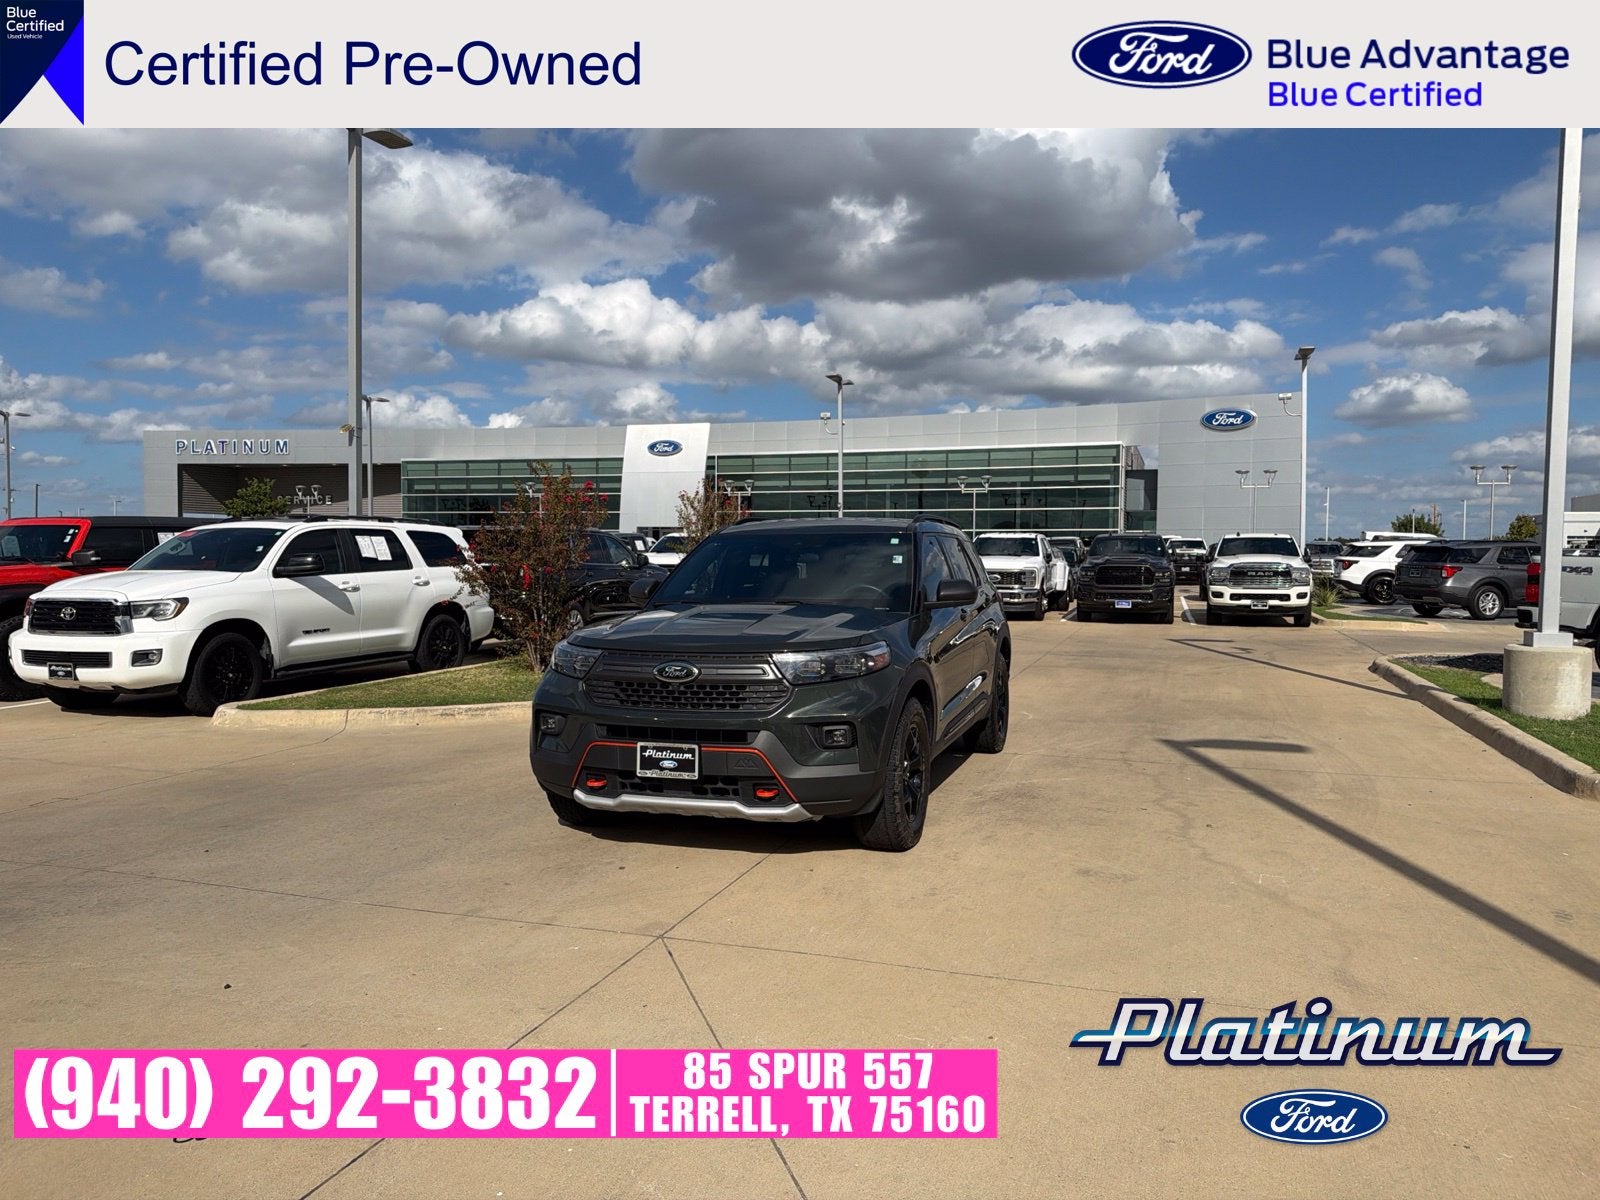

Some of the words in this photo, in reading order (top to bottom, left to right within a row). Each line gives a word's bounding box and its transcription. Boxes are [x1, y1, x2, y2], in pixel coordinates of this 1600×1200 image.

[1212, 412, 1244, 426] Ford
[175, 439, 290, 455] PLATINUM
[653, 442, 675, 452] Ford
[662, 665, 687, 677] Ford
[642, 749, 695, 760] Platinum
